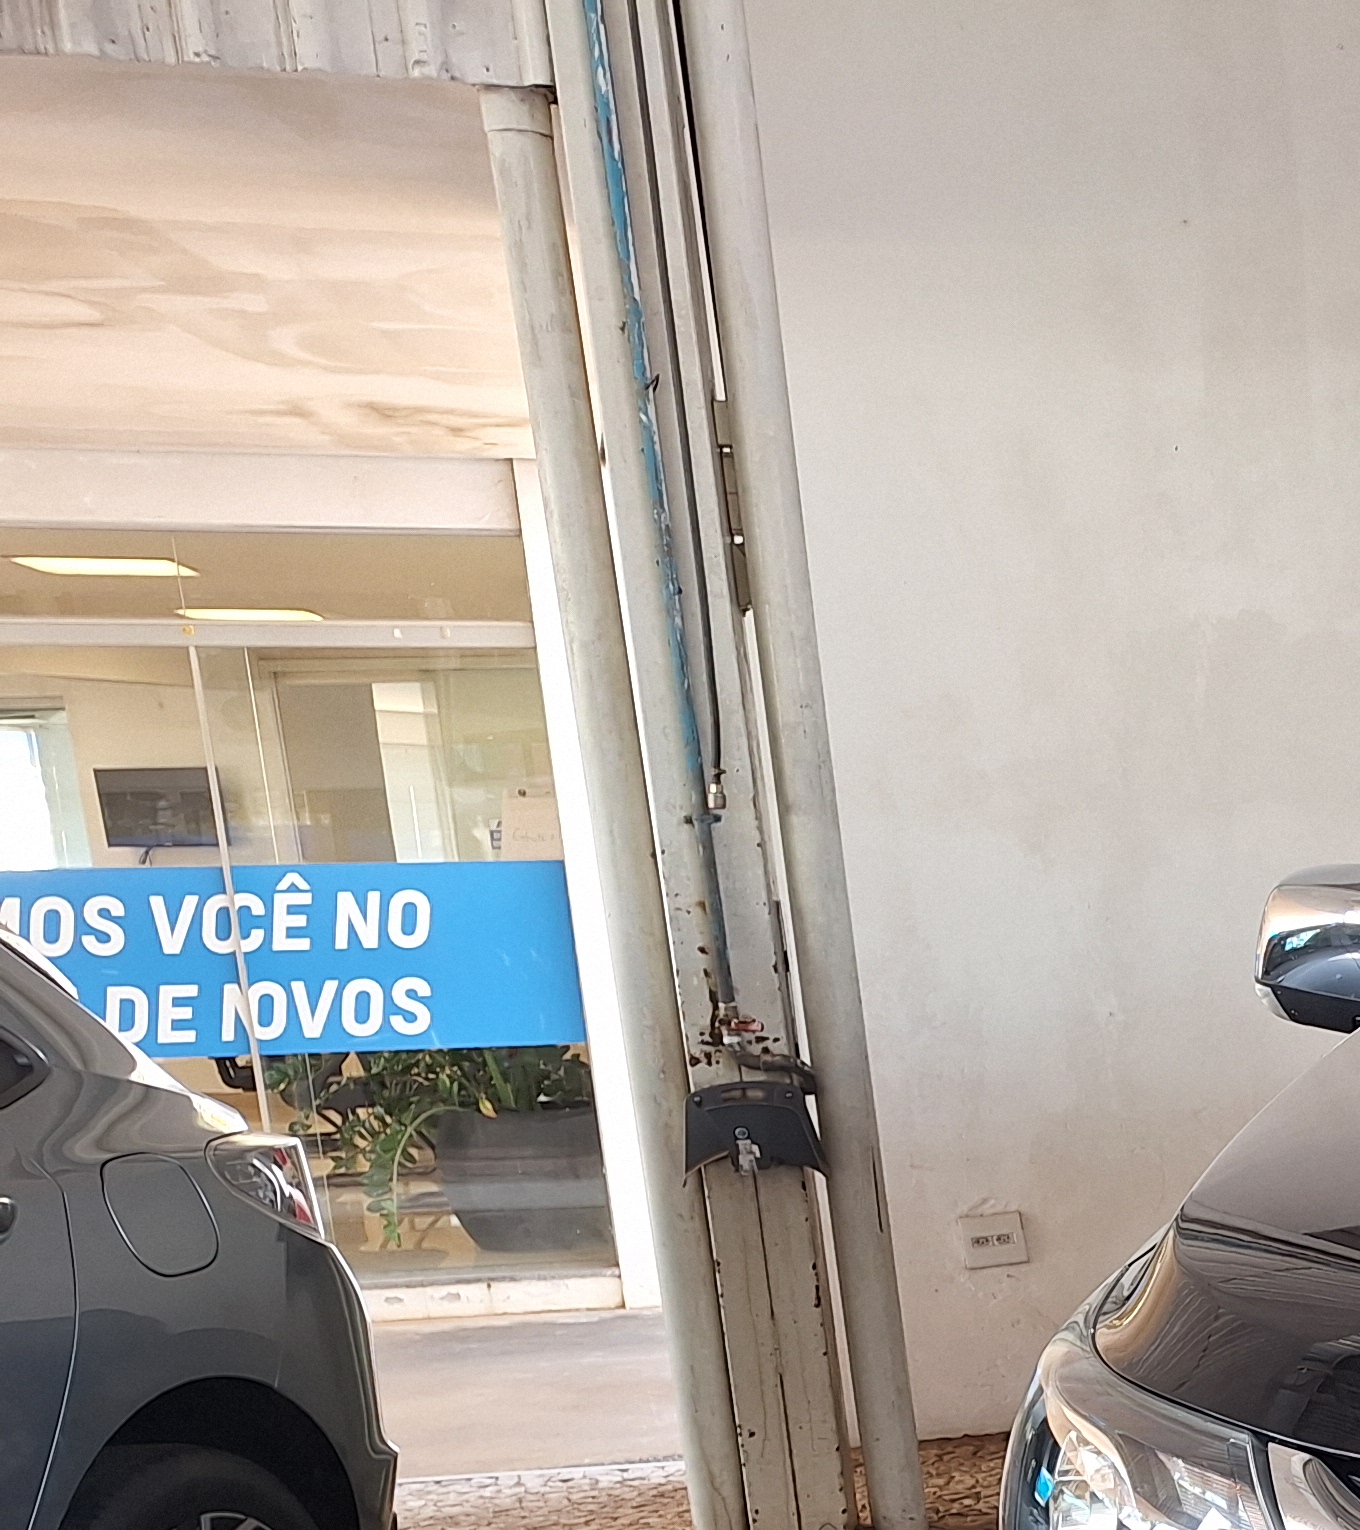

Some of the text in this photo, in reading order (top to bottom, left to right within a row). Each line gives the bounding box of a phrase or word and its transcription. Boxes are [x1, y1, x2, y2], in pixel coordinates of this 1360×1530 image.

[149, 872, 313, 955] VOCÊ
[334, 889, 431, 950] NO
[105, 984, 199, 1044] DE
